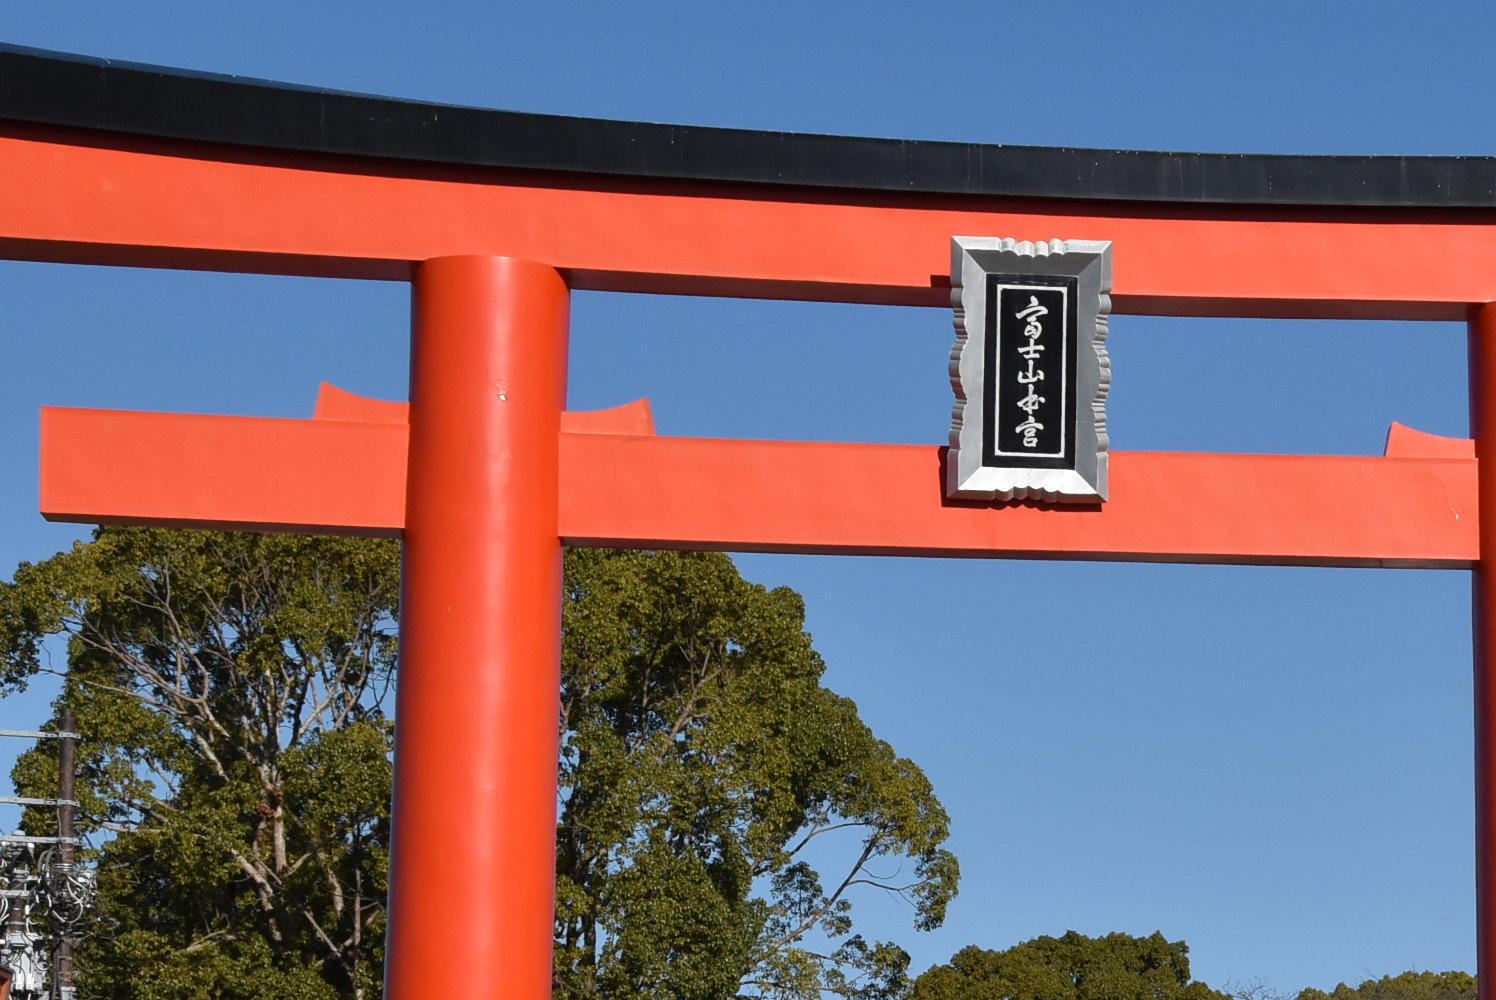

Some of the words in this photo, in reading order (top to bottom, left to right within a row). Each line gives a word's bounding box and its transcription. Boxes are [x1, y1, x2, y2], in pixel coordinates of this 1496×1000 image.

[1015, 295, 1049, 448] 富士山本宮
